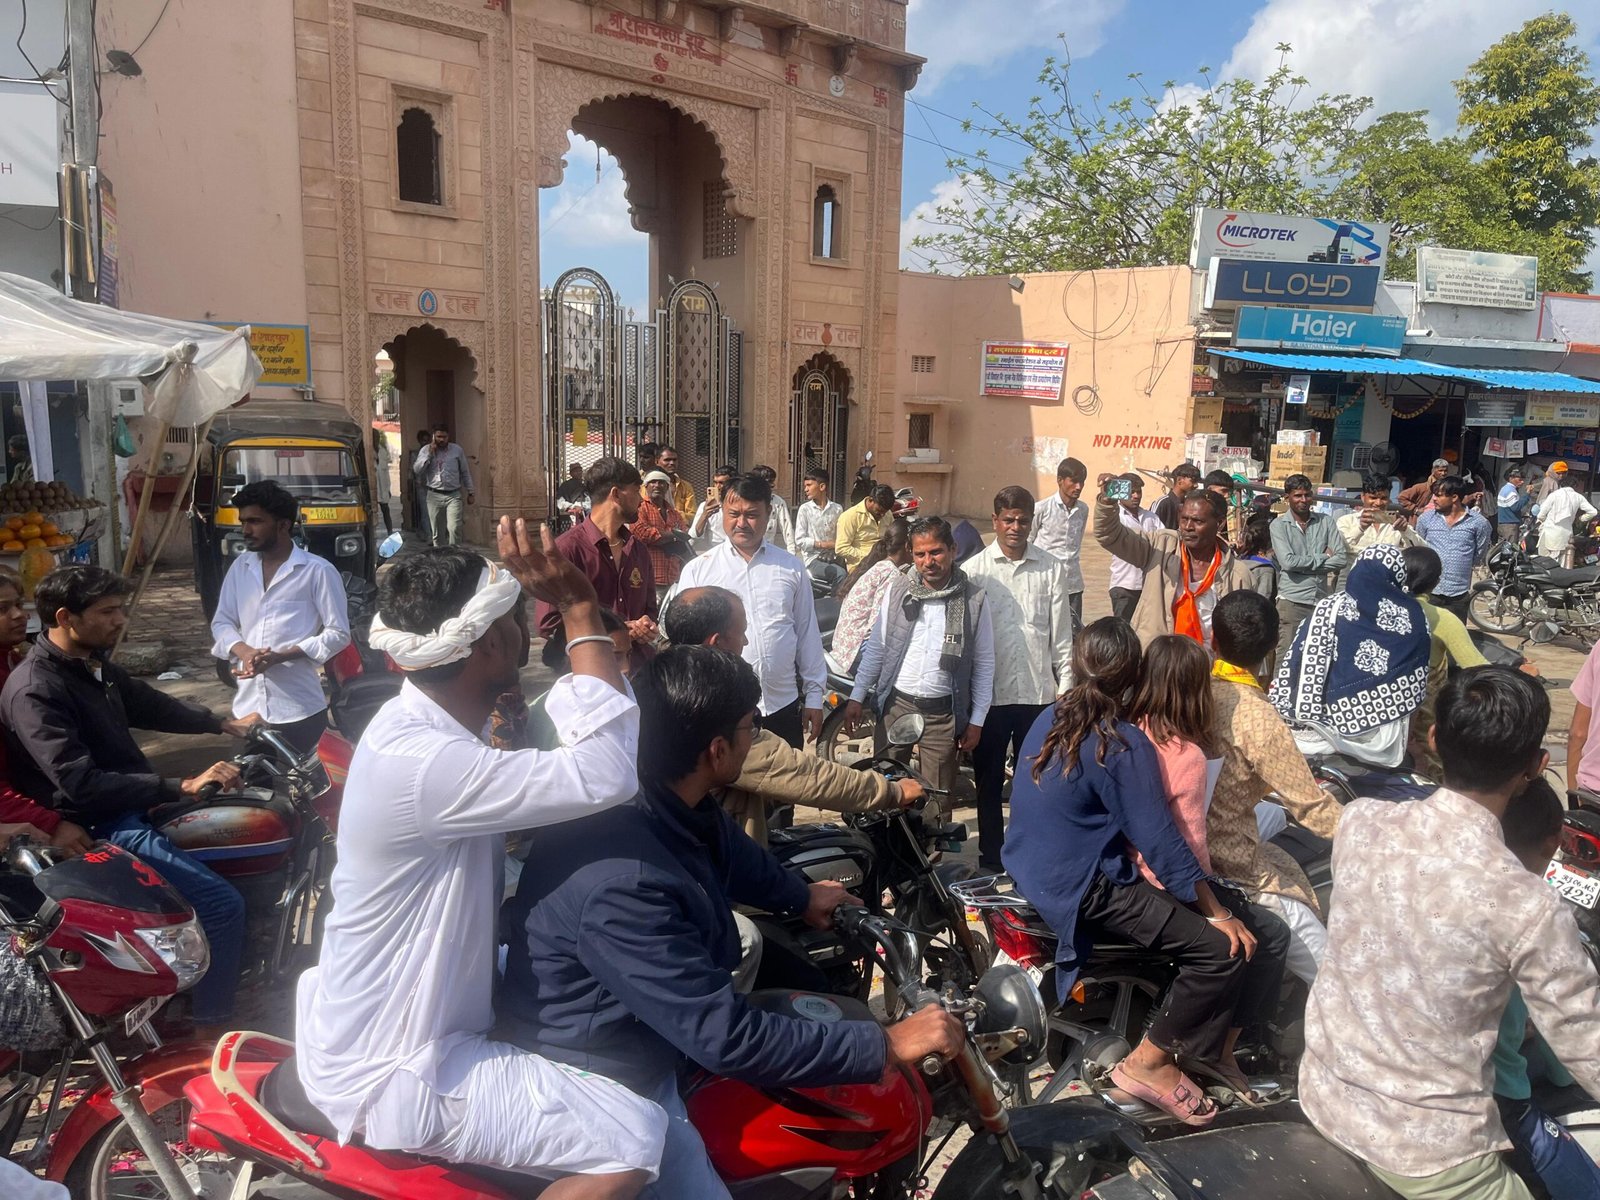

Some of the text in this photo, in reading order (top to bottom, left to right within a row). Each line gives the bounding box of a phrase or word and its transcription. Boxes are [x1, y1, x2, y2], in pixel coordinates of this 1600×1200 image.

[1223, 225, 1298, 241] MICROTEK
[1242, 271, 1351, 297] LLOYD
[371, 289, 480, 315] राम राम
[682, 295, 705, 311] राम
[794, 324, 860, 343] राम राम
[1291, 313, 1356, 338] Haier
[810, 382, 822, 391] राम
[1093, 434, 1172, 450] NO PARKING
[1221, 447, 1249, 455] SURYA
[1555, 880, 1594, 906] 7423
